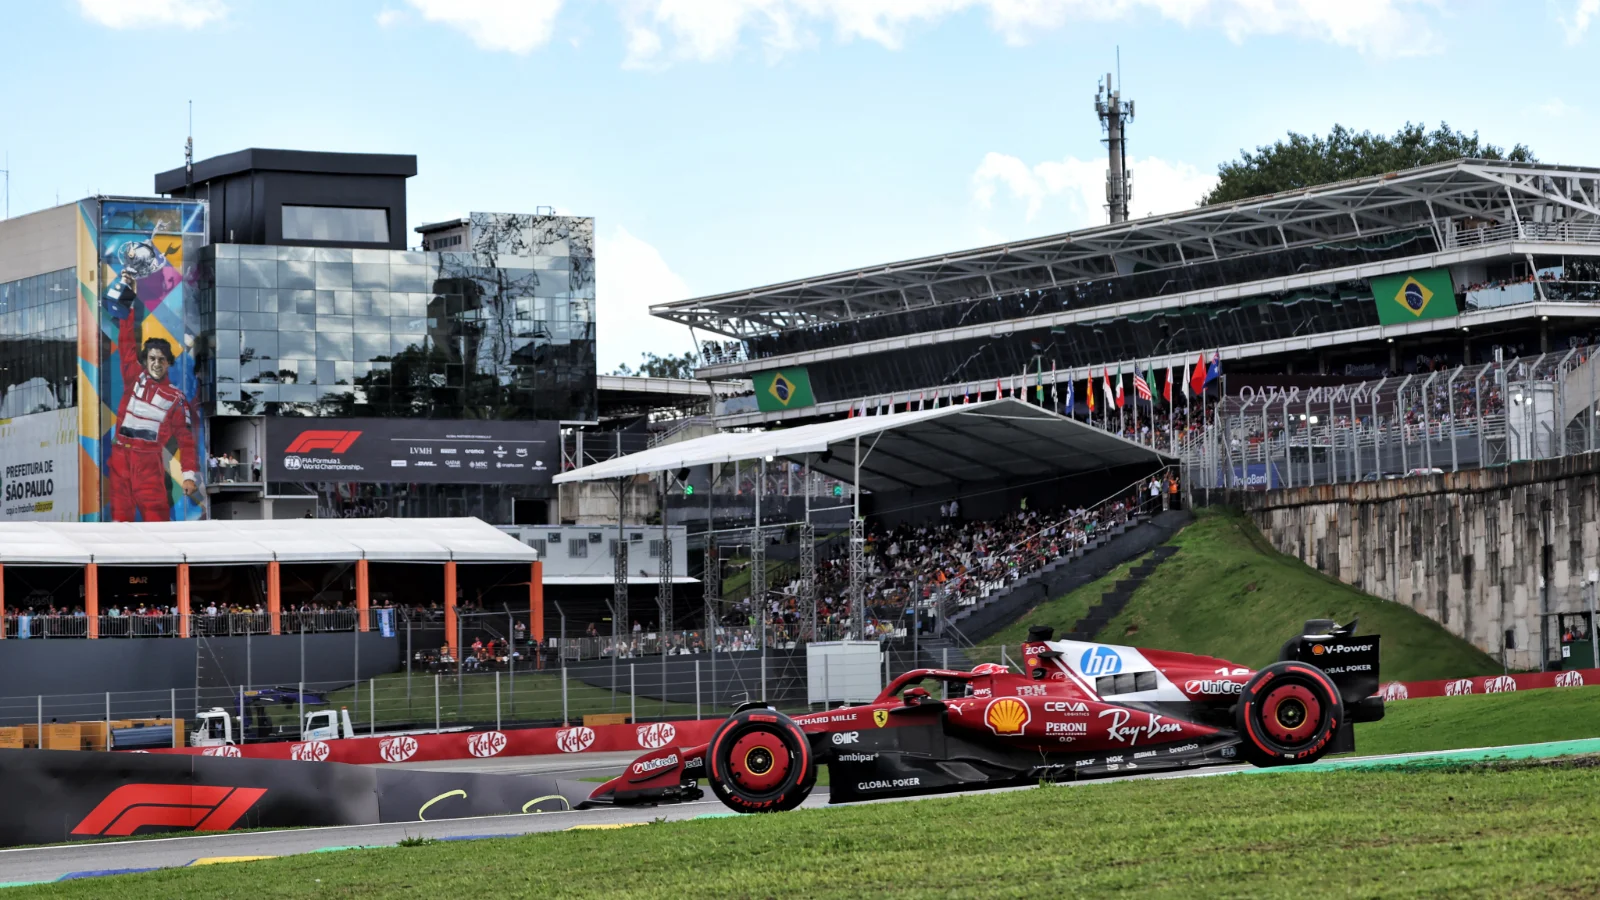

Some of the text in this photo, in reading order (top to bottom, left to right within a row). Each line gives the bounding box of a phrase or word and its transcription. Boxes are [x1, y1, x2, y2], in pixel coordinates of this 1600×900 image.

[1240, 385, 1380, 406] QATAR AIRWAYS
[284, 430, 363, 453] F1
[6, 460, 53, 478] PREFEITURA DE
[1233, 473, 1267, 486] PoroBan
[6, 478, 54, 501] SÃO PAULO
[129, 576, 148, 584] BAR
[1025, 646, 1046, 655] ZCG
[1325, 644, 1373, 654] V-Power
[1085, 646, 1119, 674] hp
[1321, 666, 1345, 674] OBAL
[974, 688, 991, 696] aws
[1016, 684, 1047, 697] IBM
[831, 714, 857, 722] MILLE
[1046, 722, 1087, 732] PERONI
[561, 727, 593, 751] KitKat
[641, 723, 674, 748] KitKat
[385, 737, 416, 761] KitKat
[473, 732, 504, 757] KitKat
[1169, 743, 1199, 753] brembo
[1298, 729, 1332, 759] ZERO
[295, 742, 328, 761] KitKat
[839, 753, 874, 763] ambipar
[1221, 747, 1236, 757] FIA
[643, 754, 678, 771] UniCredit
[1075, 759, 1096, 767] SKF
[858, 778, 920, 790] GLOBAL POKER
[730, 795, 773, 808] ZERO
[70, 783, 268, 836] F1
